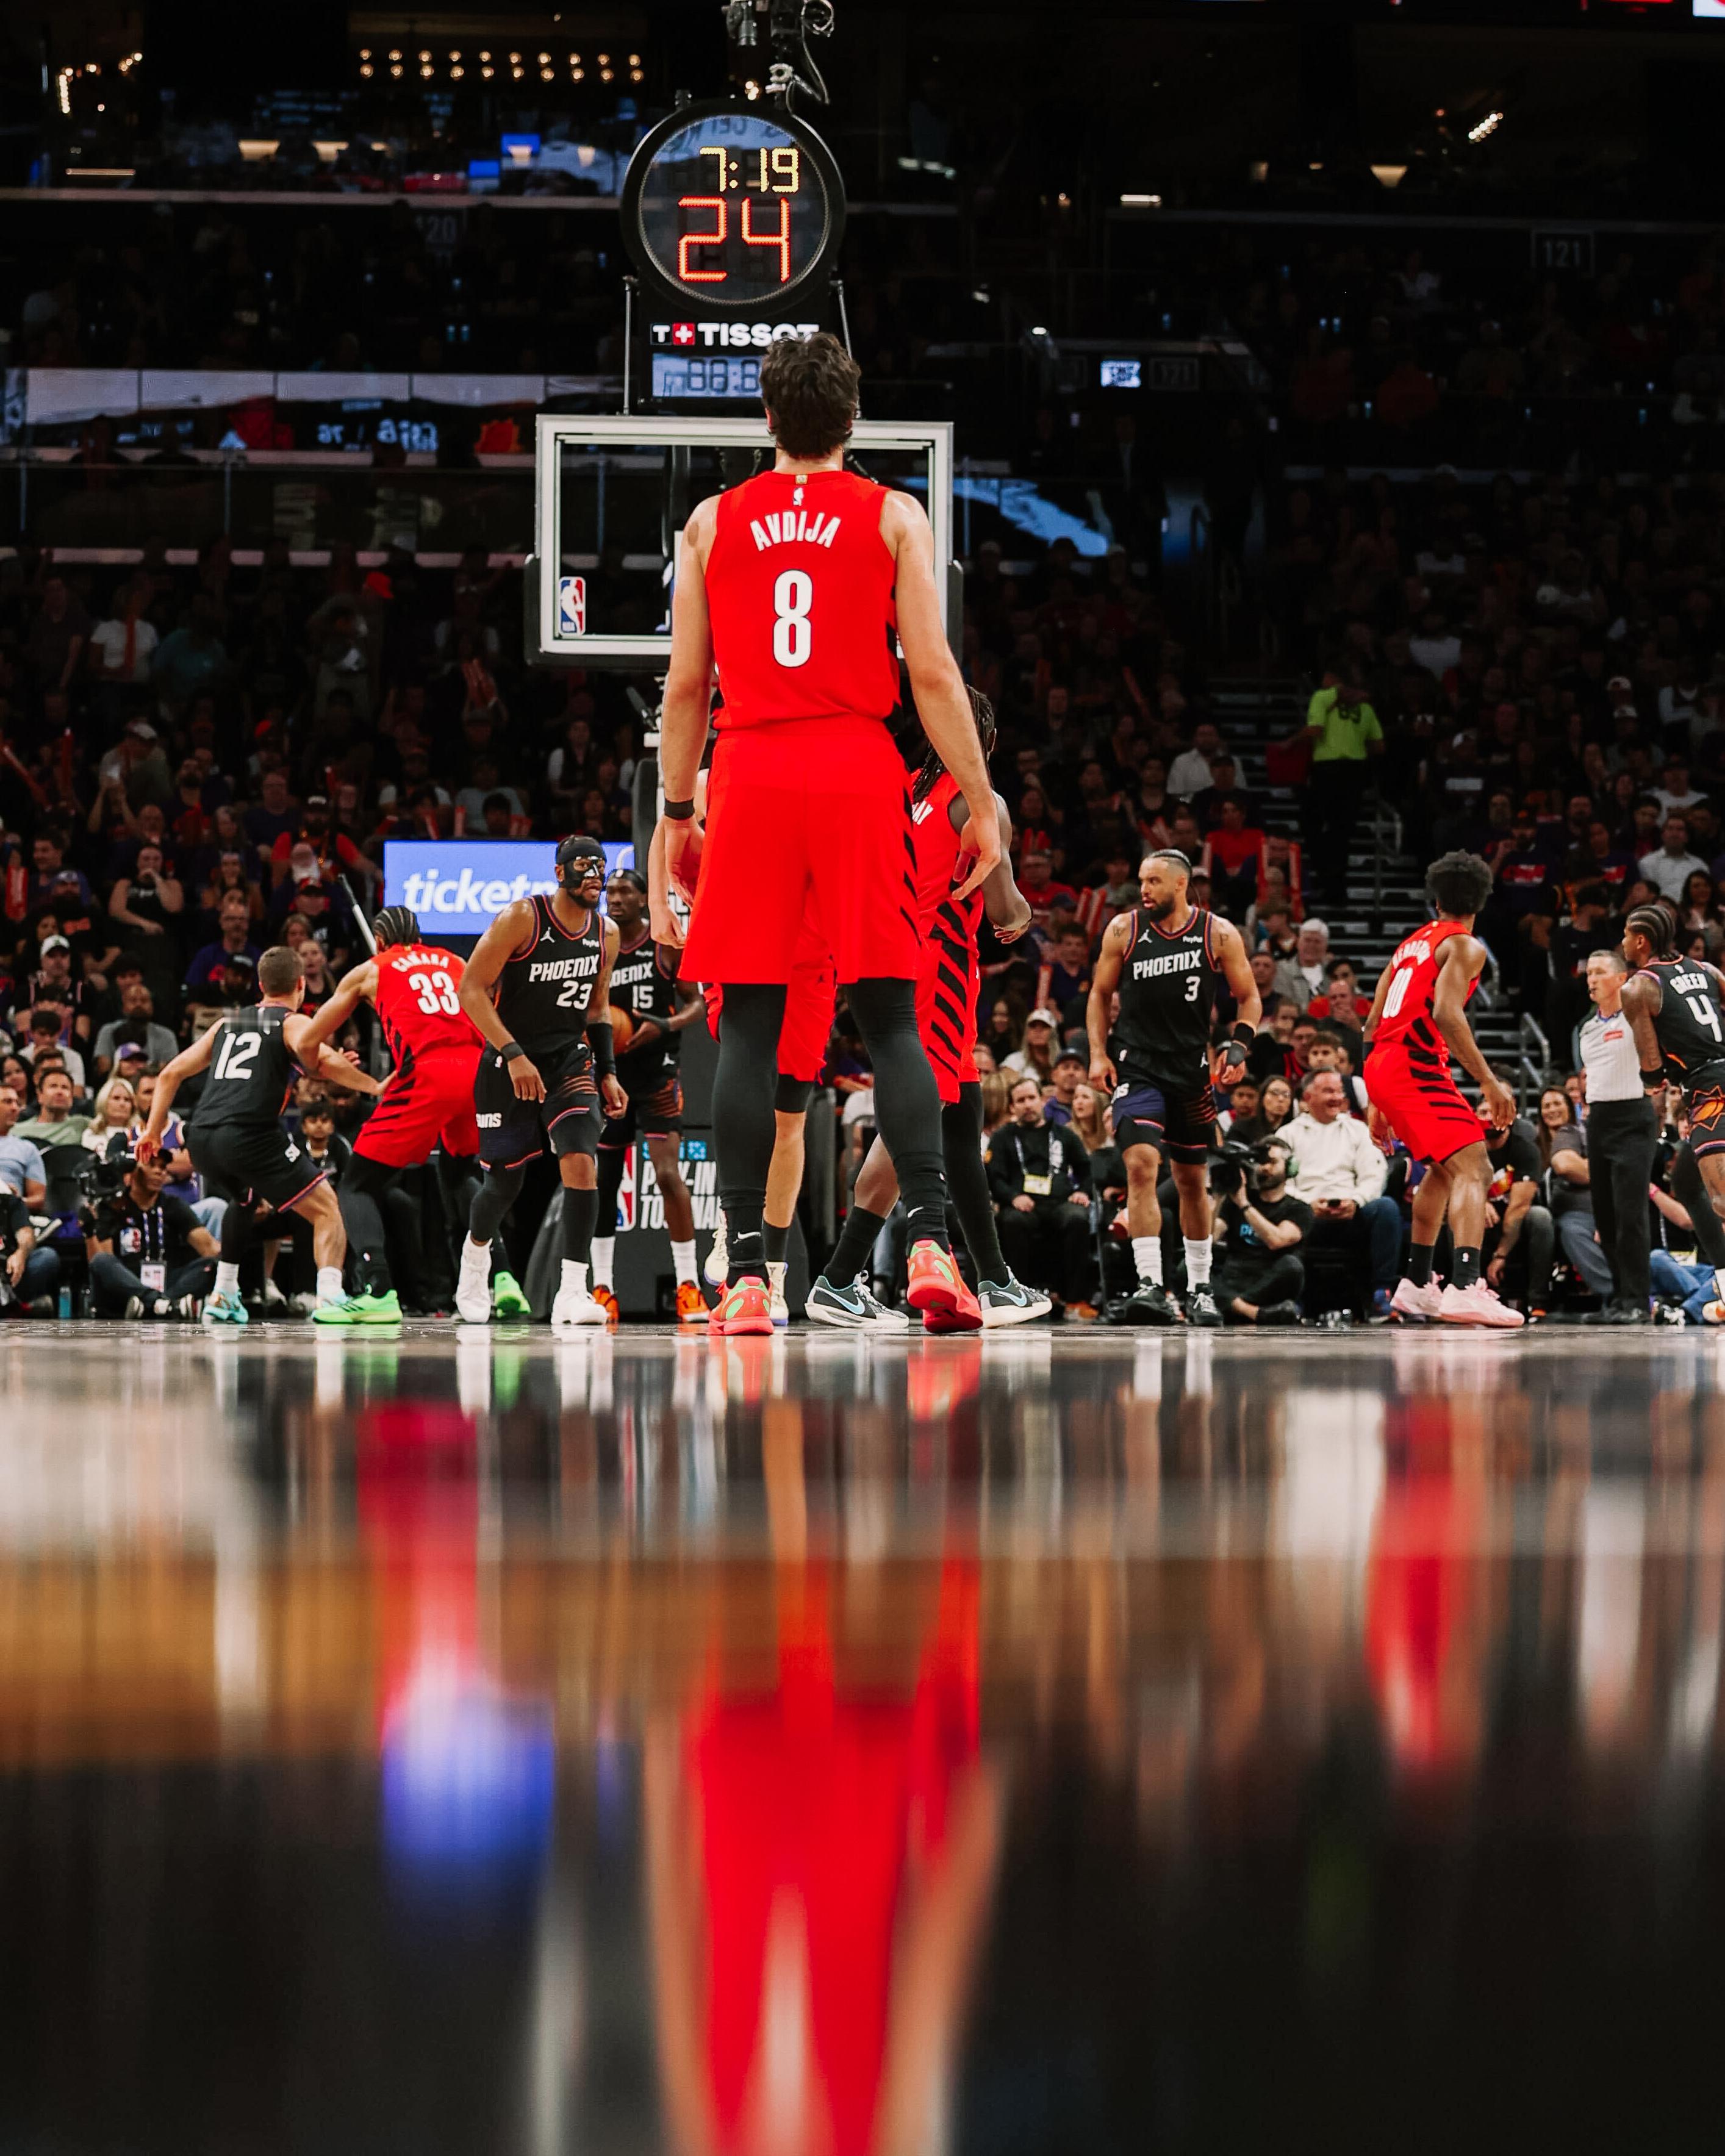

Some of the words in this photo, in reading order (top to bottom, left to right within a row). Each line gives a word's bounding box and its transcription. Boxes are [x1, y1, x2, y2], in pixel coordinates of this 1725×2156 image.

[700, 147, 799, 193] 7:19
[678, 195, 790, 283] 24
[697, 323, 820, 347] TISSOT
[750, 510, 842, 552] AVDIJA
[772, 568, 813, 669] 8
[528, 954, 600, 983] PHOENIX
[609, 961, 654, 988] OENIX
[1133, 948, 1202, 980] PHOENIX
[408, 971, 461, 1015] 33
[556, 980, 593, 1011] 23
[632, 984, 654, 1009] 15
[1185, 976, 1201, 1002] 3
[1669, 972, 1709, 995] GREEN
[1685, 994, 1723, 1043] 4
[214, 1031, 262, 1080] 12
